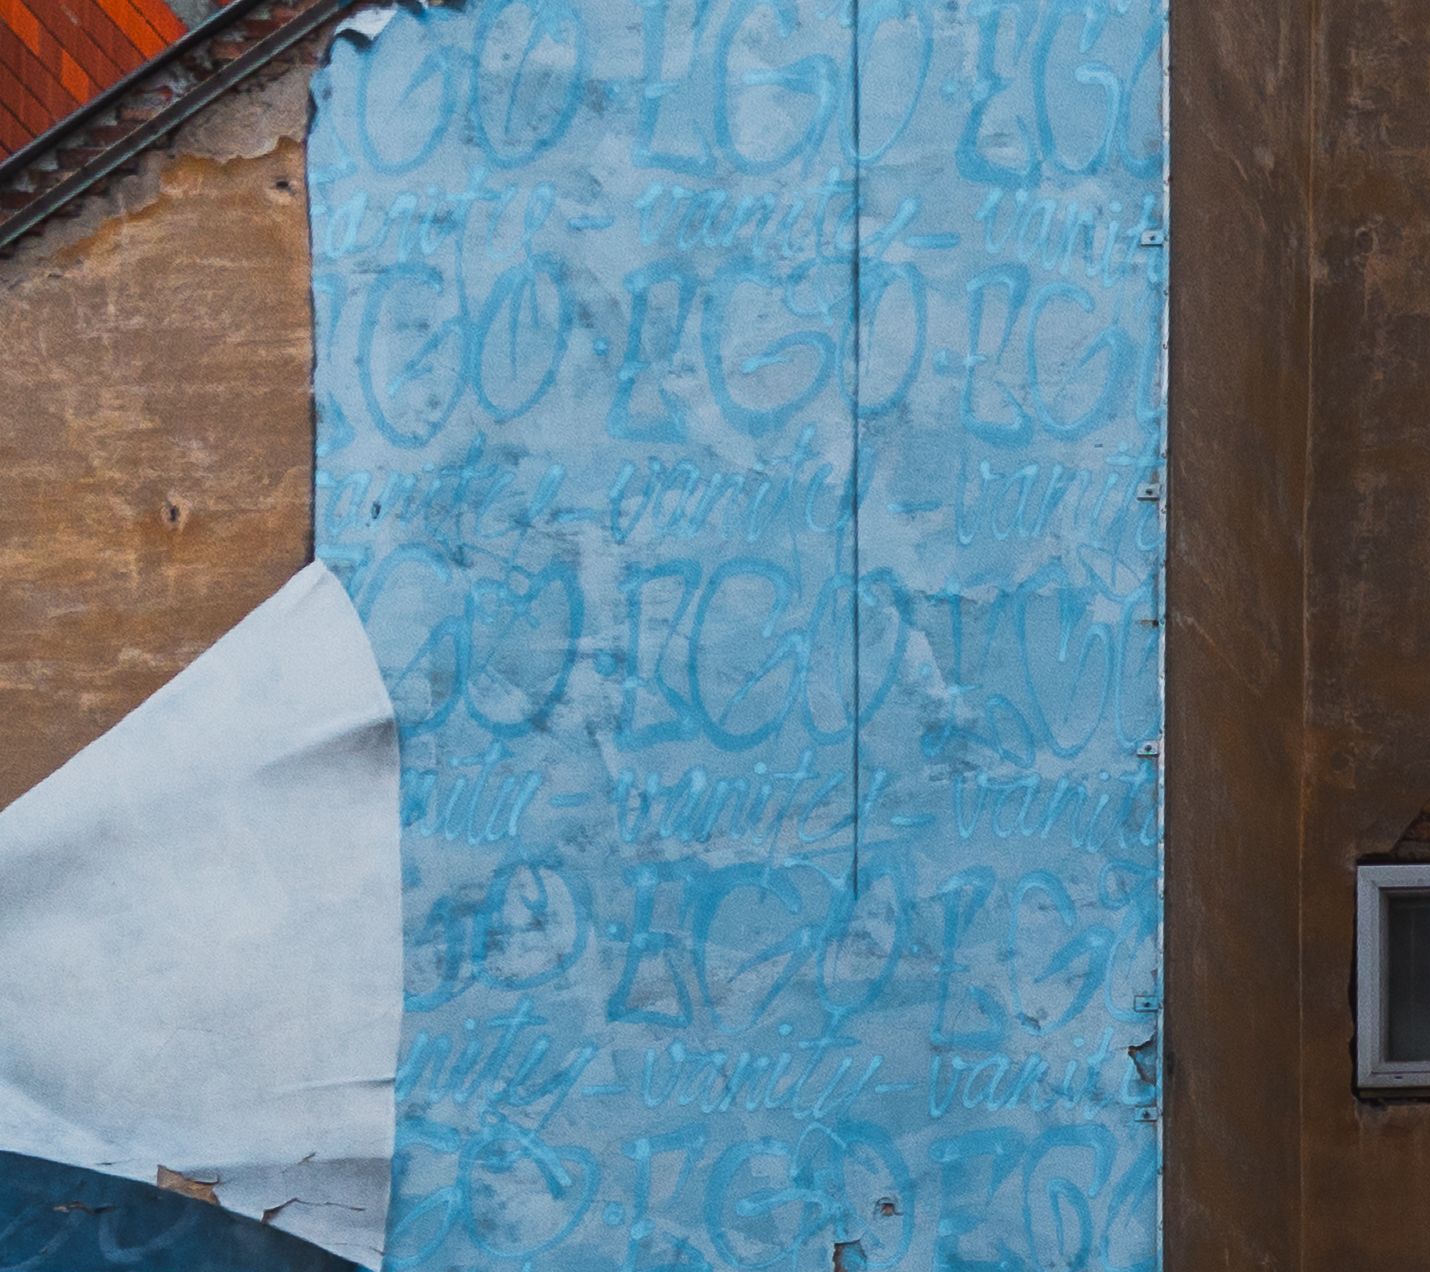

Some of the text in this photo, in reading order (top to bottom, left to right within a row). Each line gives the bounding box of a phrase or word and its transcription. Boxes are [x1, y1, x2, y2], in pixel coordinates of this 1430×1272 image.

[312, 165, 557, 262] anity
[956, 262, 1163, 446] EG
[314, 430, 572, 555] anity
